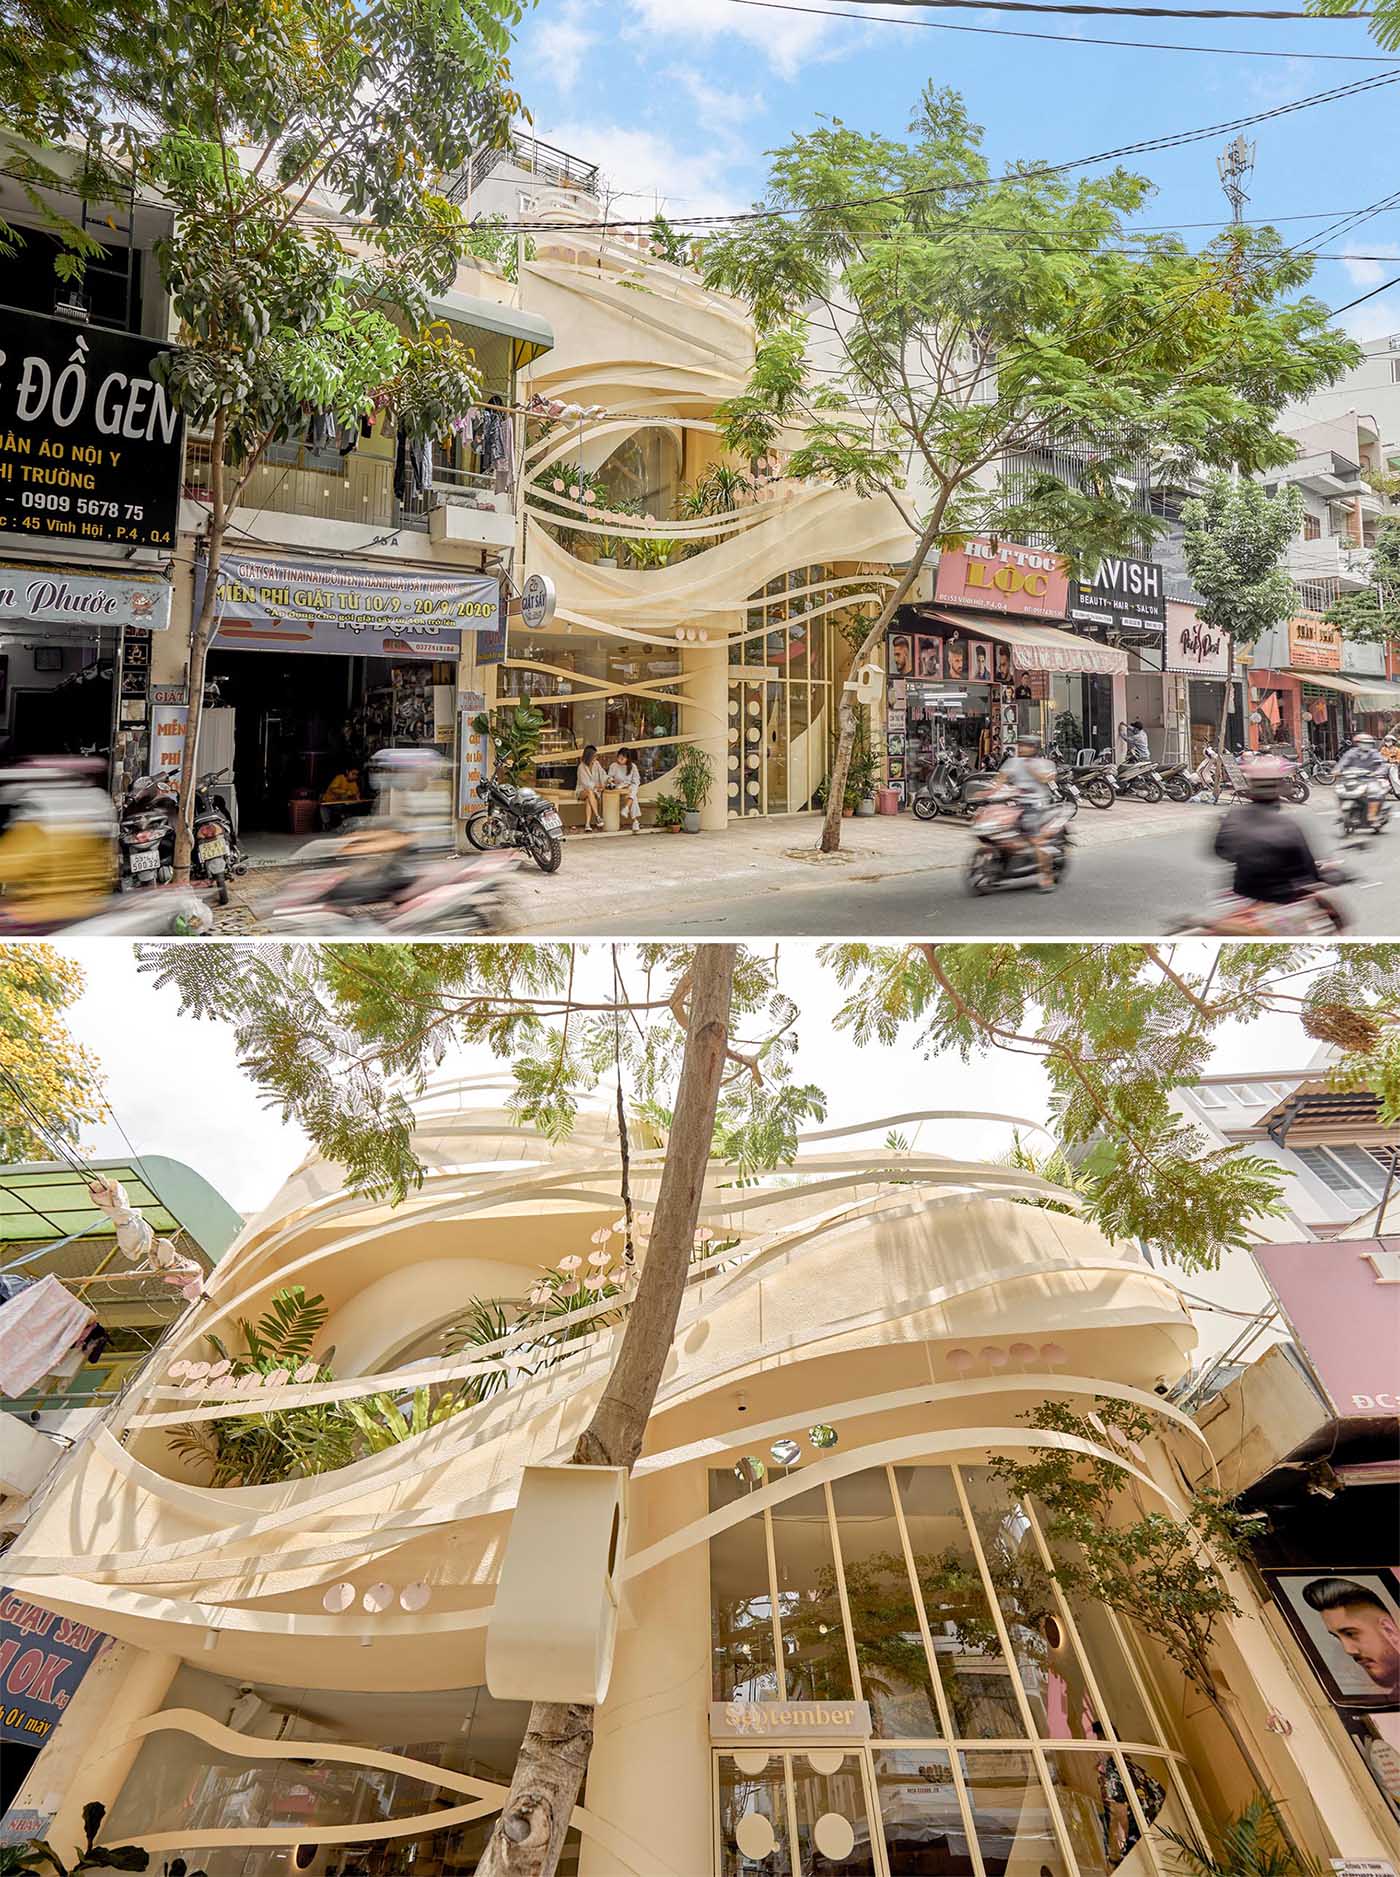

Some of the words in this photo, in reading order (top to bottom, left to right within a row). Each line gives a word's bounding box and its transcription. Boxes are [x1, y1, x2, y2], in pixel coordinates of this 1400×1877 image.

[17, 334, 90, 428] ĐỒ
[95, 372, 177, 444] GEN
[38, 438, 65, 459] ÁO
[71, 445, 103, 467] NỘI
[110, 451, 121, 468] Y
[20, 465, 96, 490] TRƯỜNG
[21, 491, 70, 512] 0909
[77, 499, 119, 518] 5678
[124, 504, 144, 521] 75
[22, 517, 41, 530] 45
[47, 519, 76, 534] Vĩnh
[82, 523, 103, 538] Hội
[117, 529, 138, 540] P.4
[150, 531, 170, 543] Q.4
[965, 562, 1050, 599] LỘC
[26, 580, 118, 615] Phước
[217, 580, 256, 603] MIỄN
[259, 586, 290, 606] PHÍ
[294, 587, 334, 611] GIẶT
[338, 591, 362, 610] TỪ
[364, 594, 401, 612] 10/9
[1080, 594, 1107, 607] BEAUTY
[1113, 600, 1129, 610] HAIR
[1136, 604, 1159, 615] SALON
[157, 718, 187, 736] MIỄN
[161, 749, 181, 765] PHÍ
[24, 1717, 53, 1738] máy
[725, 1701, 855, 1728] September
